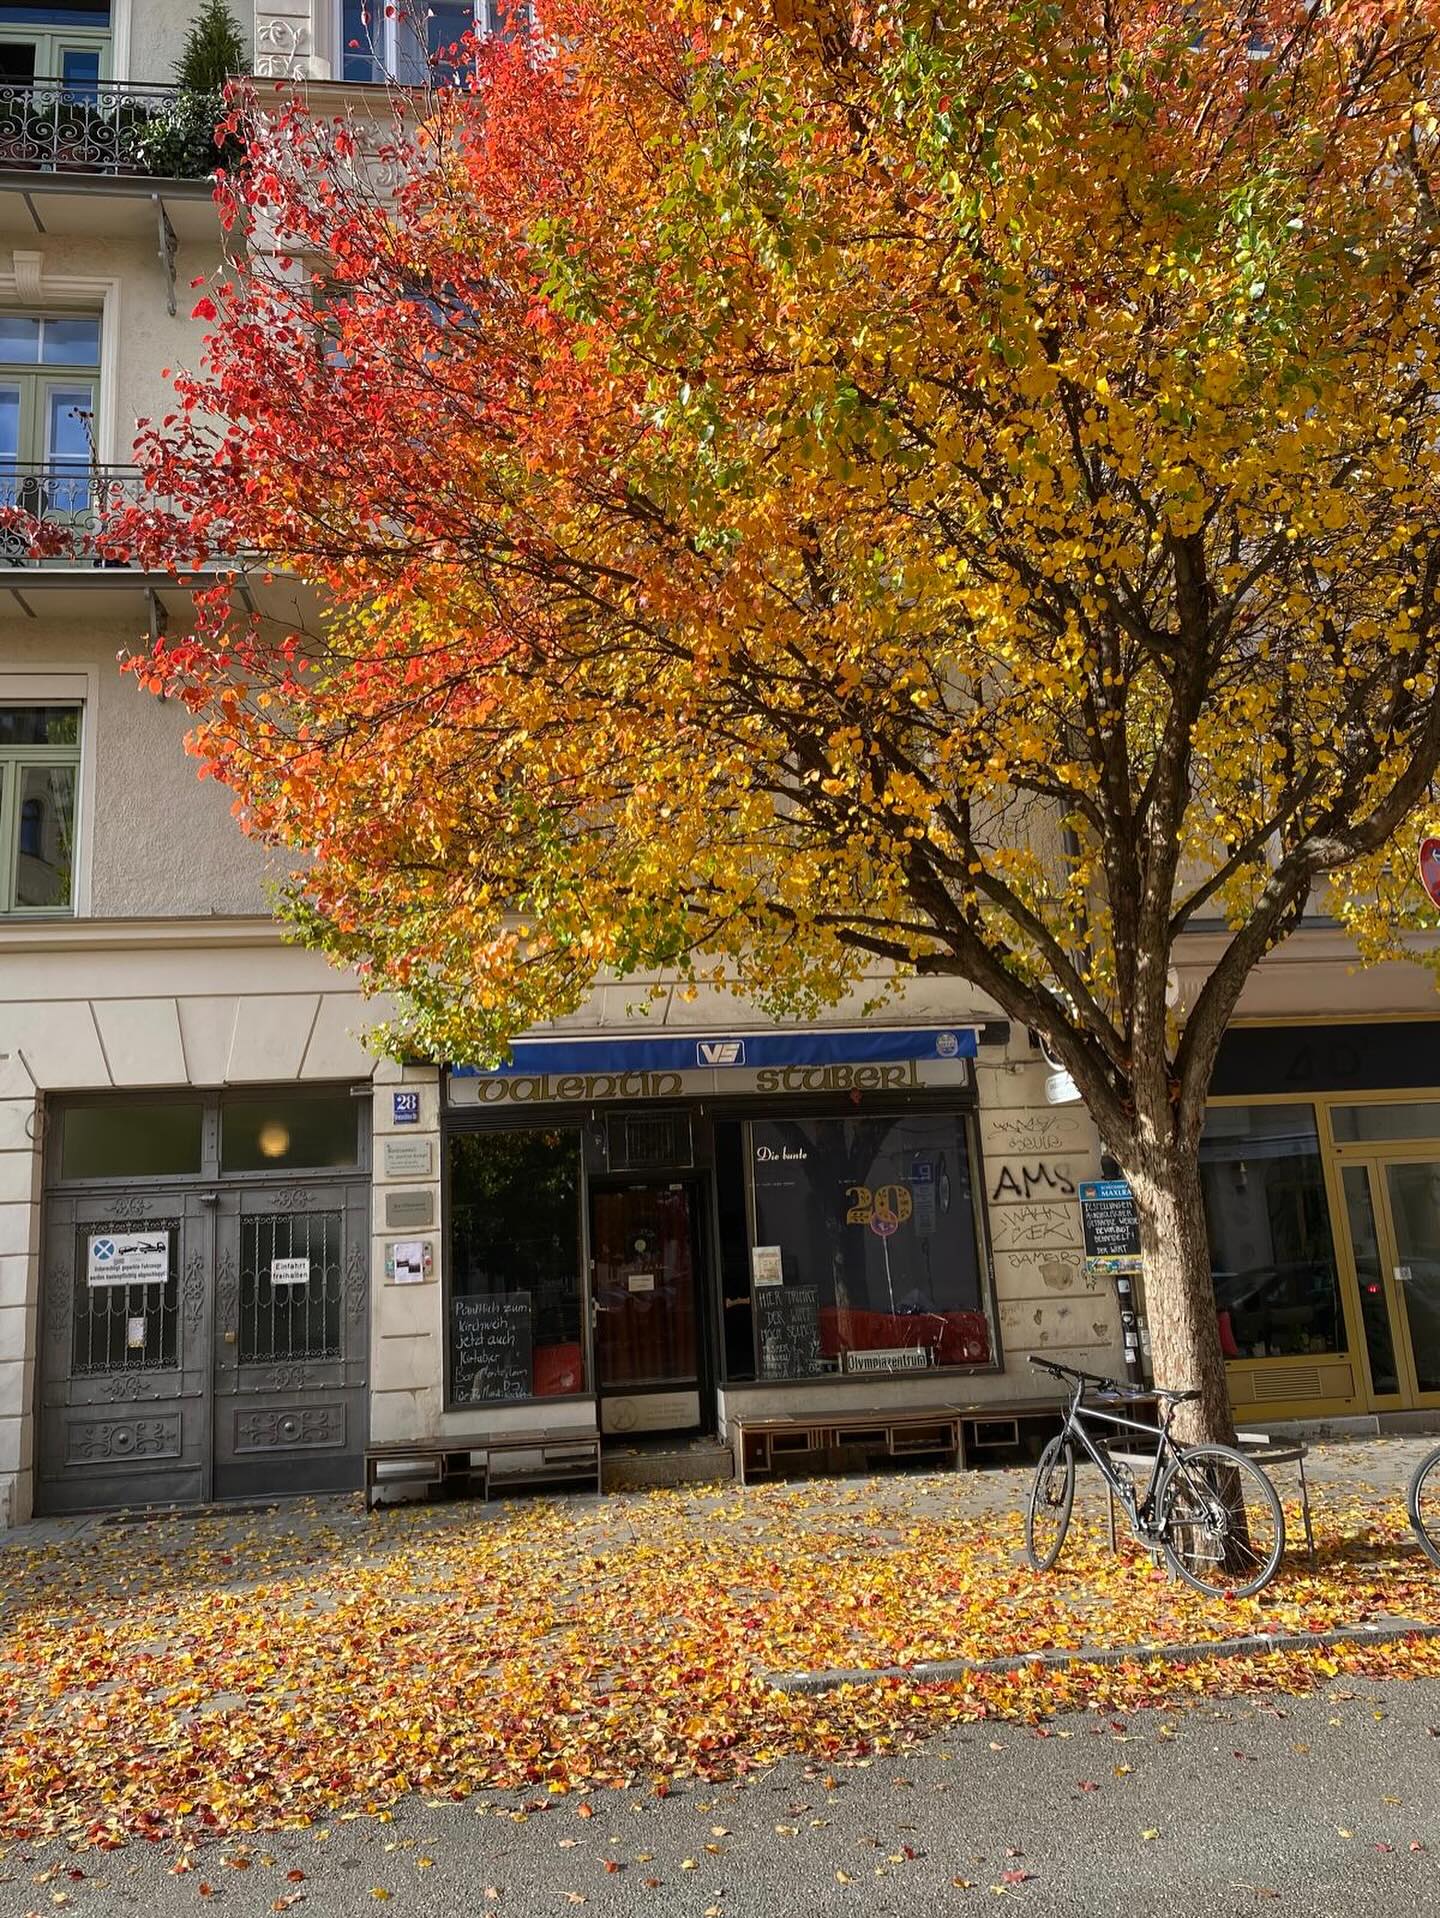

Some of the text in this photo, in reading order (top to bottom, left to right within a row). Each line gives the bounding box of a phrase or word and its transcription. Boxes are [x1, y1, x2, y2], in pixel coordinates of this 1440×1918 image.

[396, 1095, 417, 1110] 28
[756, 1146, 808, 1162] Die bunte
[992, 1161, 1075, 1200] AMS
[845, 1184, 913, 1225] 20
[276, 1262, 306, 1270] Einfahrt
[273, 1271, 308, 1280] freihalten
[487, 1330, 516, 1346] auch
[849, 1353, 927, 1370] Olympiazentrum
